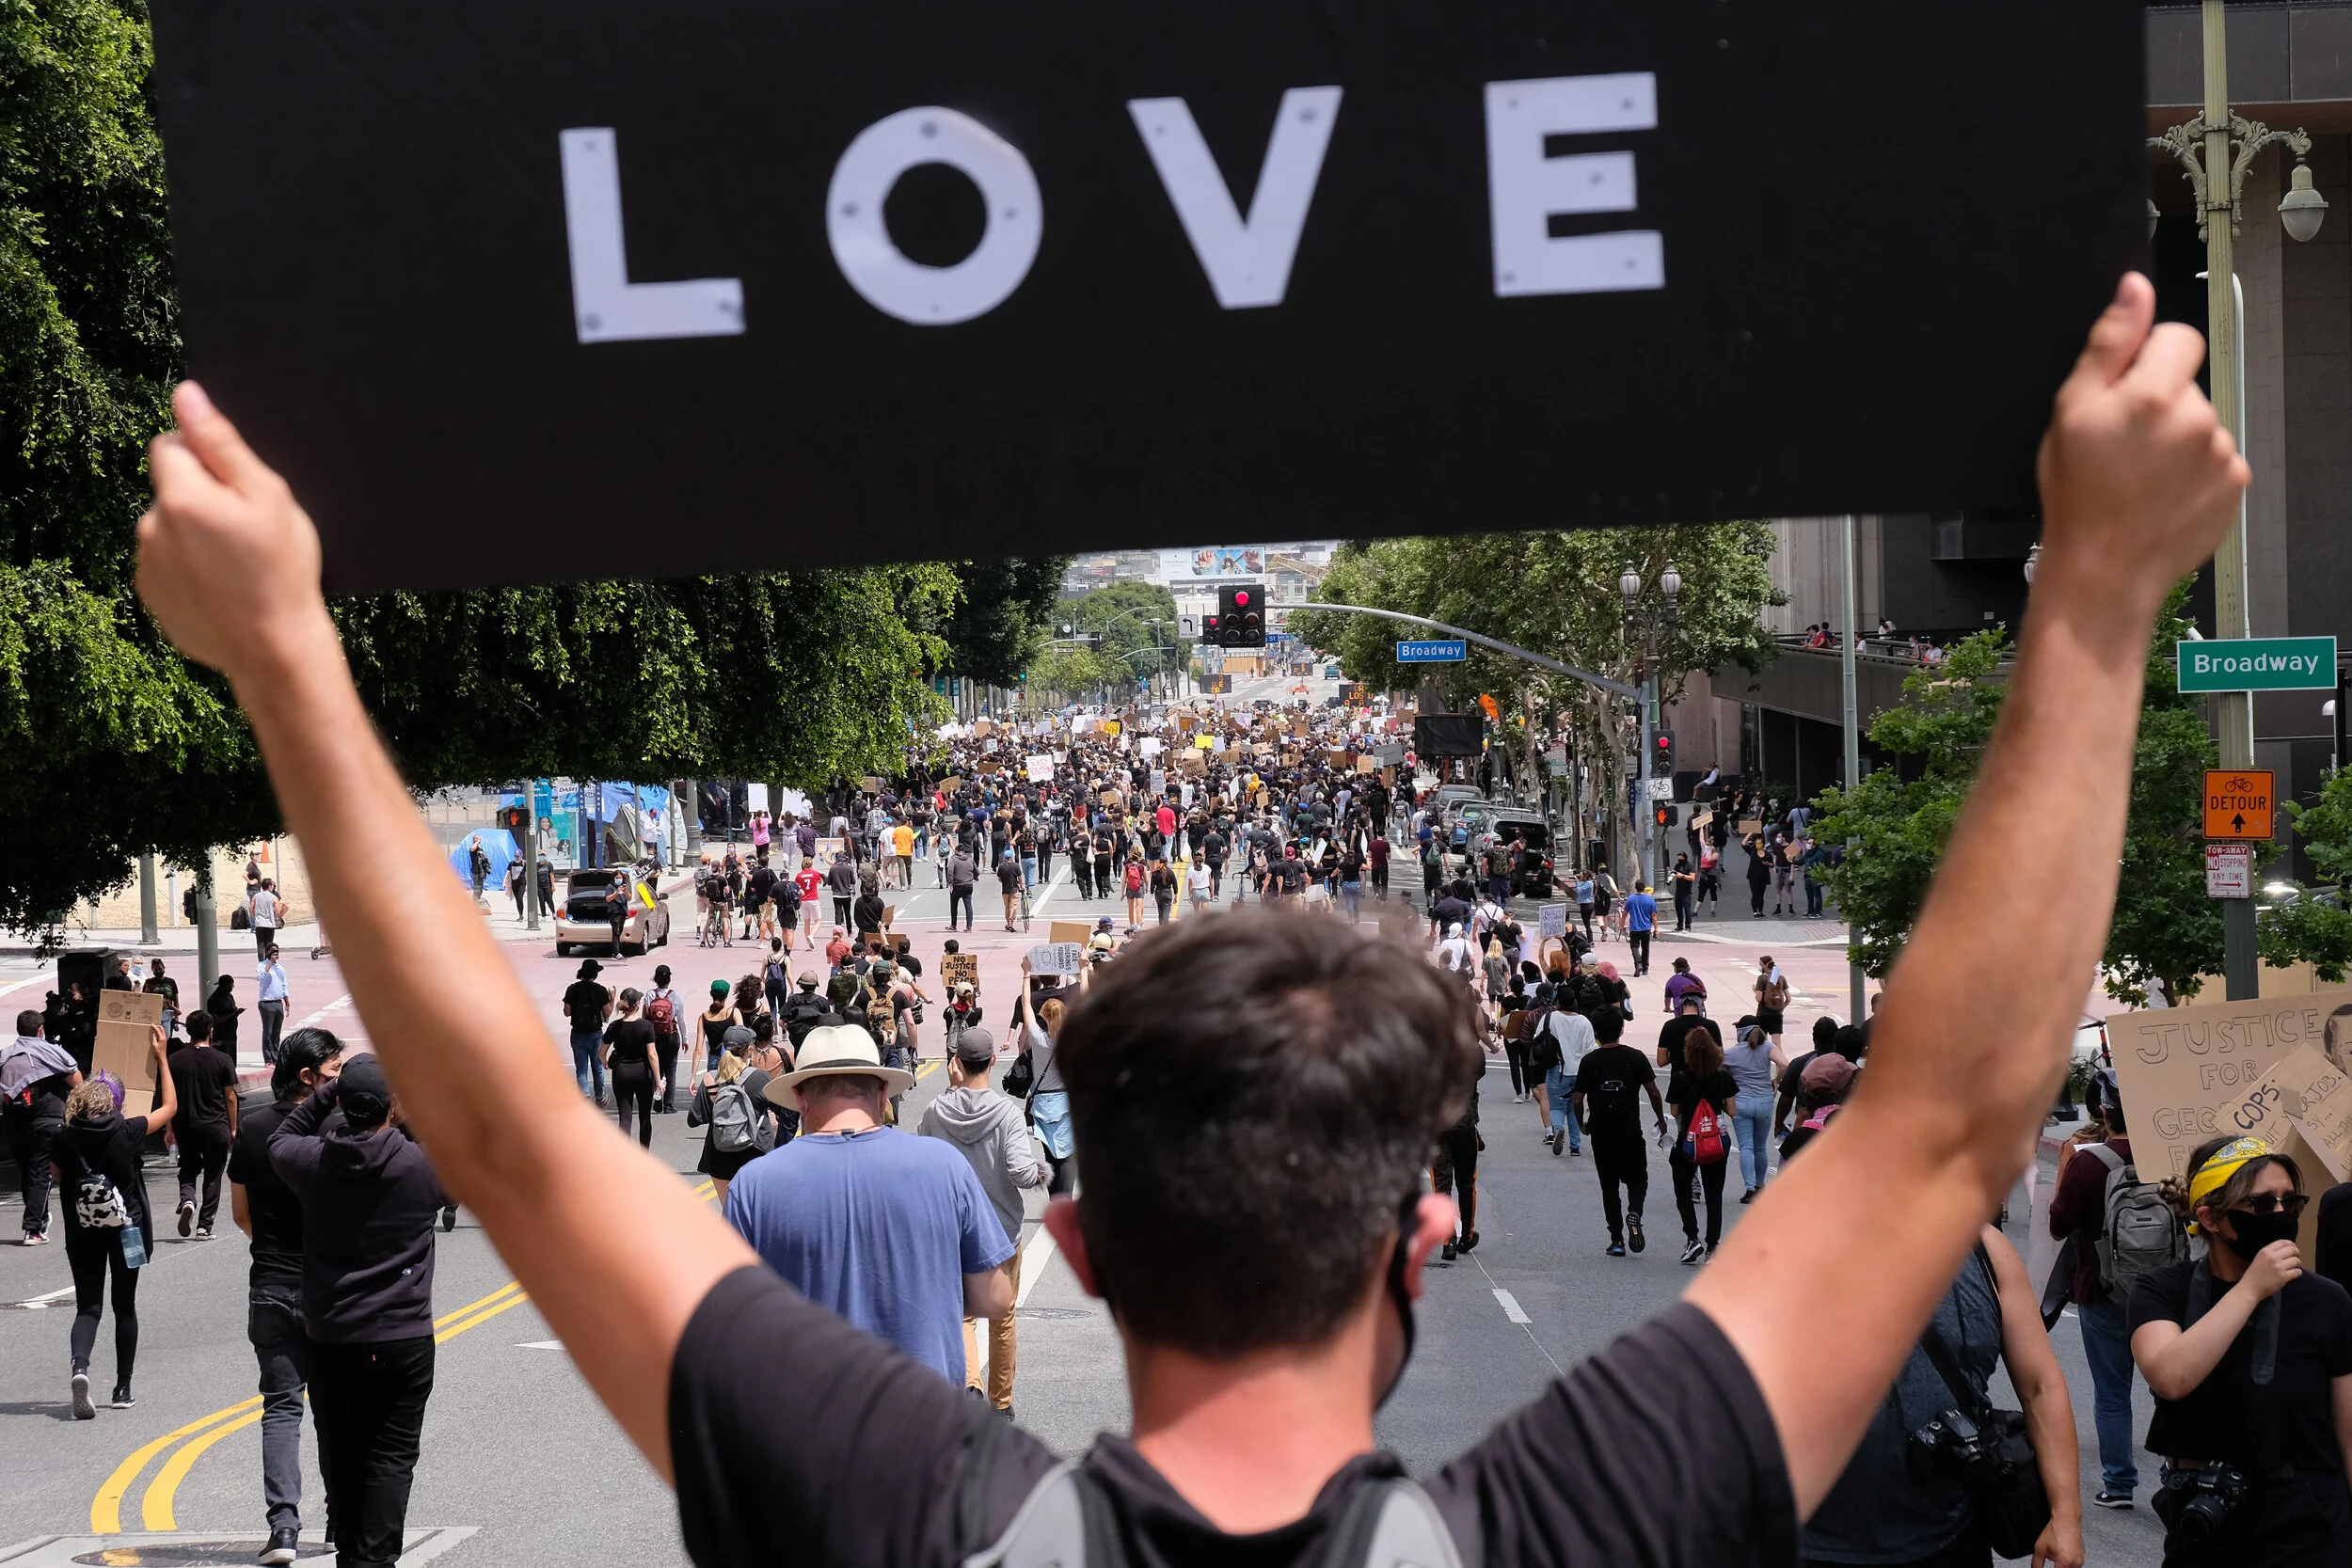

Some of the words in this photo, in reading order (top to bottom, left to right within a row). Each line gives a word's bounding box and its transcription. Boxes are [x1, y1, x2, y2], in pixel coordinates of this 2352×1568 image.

[560, 71, 1665, 344] LOVE
[1402, 644, 1461, 657] Broadway
[2195, 653, 2319, 675] Broadway
[2211, 797, 2266, 811] DETOUR
[2208, 856, 2219, 870] NO
[2220, 858, 2246, 867] STOPPING
[804, 879, 811, 890] 7
[946, 962, 977, 971] JUSTICE
[953, 956, 966, 964] NO
[955, 970, 968, 978] NO
[2137, 1009, 2322, 1064] JUSTICE
[2200, 1060, 2258, 1089] FOR
